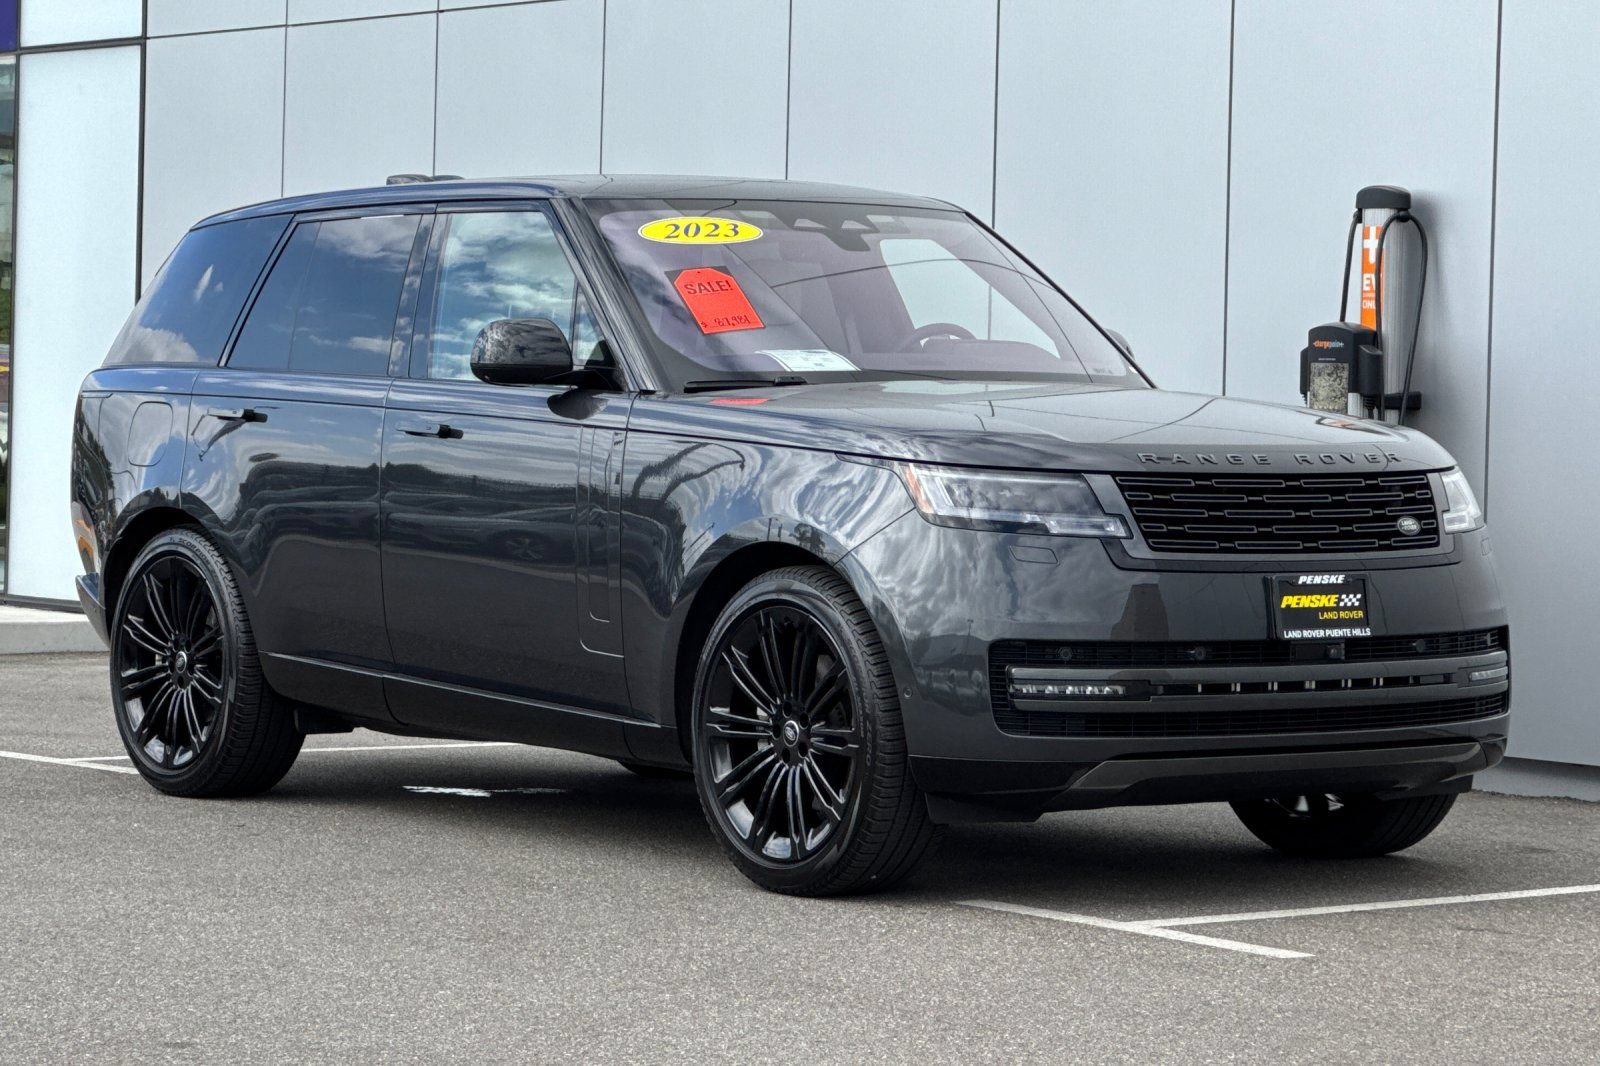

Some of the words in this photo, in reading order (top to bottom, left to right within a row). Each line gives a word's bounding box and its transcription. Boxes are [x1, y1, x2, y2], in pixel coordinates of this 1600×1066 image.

[664, 222, 740, 239] 2023
[684, 280, 733, 295] SALE!
[1136, 452, 1271, 465] RANGE
[1294, 452, 1403, 465] ROVER
[1298, 574, 1345, 585] PENSKE
[1280, 594, 1339, 608] PENSKE
[1318, 611, 1338, 620] LAND
[1339, 610, 1364, 619] ROVER
[1284, 630, 1302, 638] LAND
[1303, 629, 1325, 638] ROVER
[1325, 629, 1351, 637] PUENTE
[1352, 628, 1371, 636] HILLS
